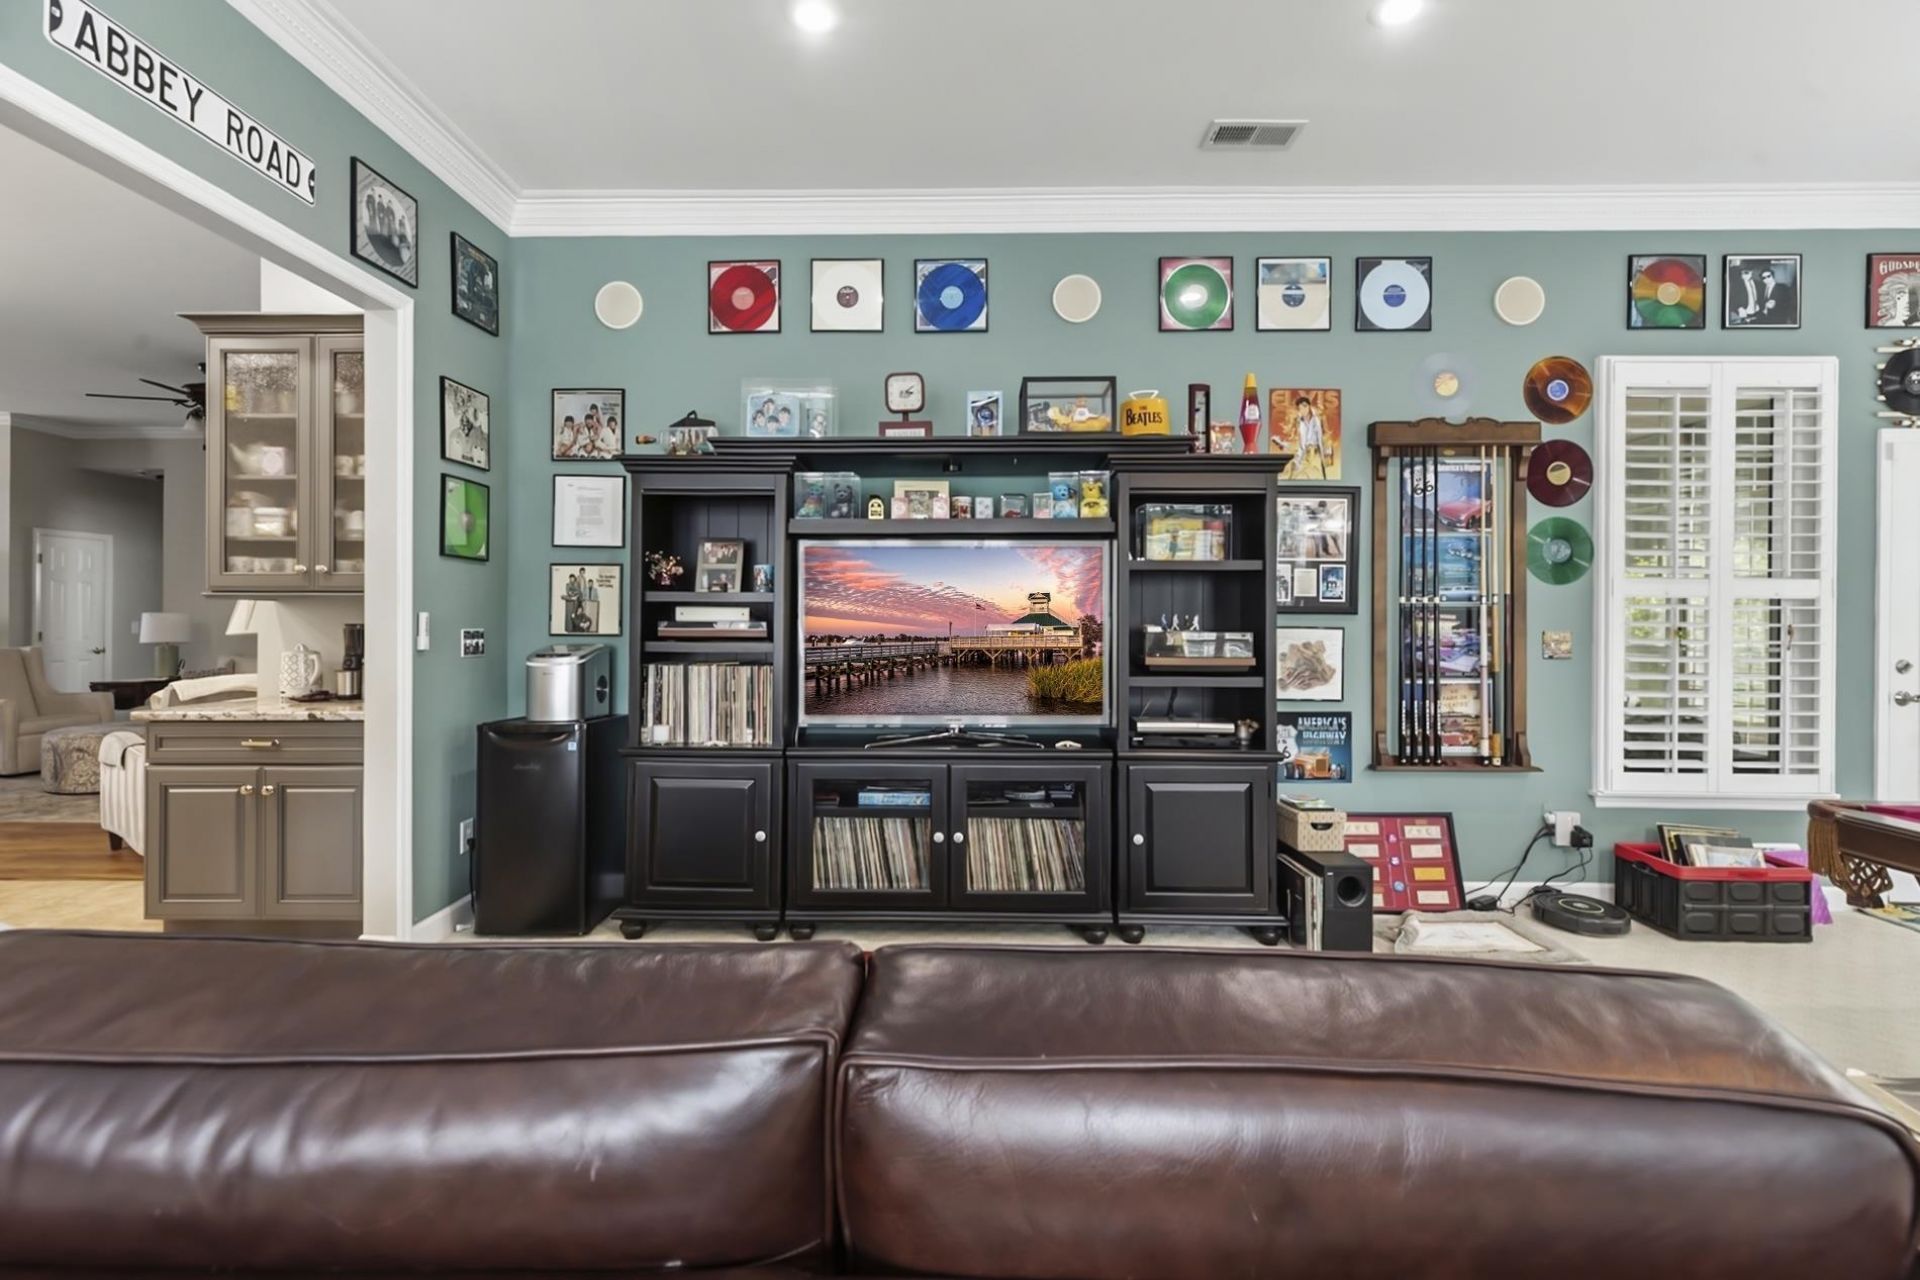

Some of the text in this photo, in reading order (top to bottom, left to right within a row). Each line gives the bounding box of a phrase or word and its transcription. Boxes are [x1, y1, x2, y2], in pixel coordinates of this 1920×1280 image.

[74, 10, 301, 188] ABBEY ROAD
[1126, 408, 1163, 426] BEATLES
